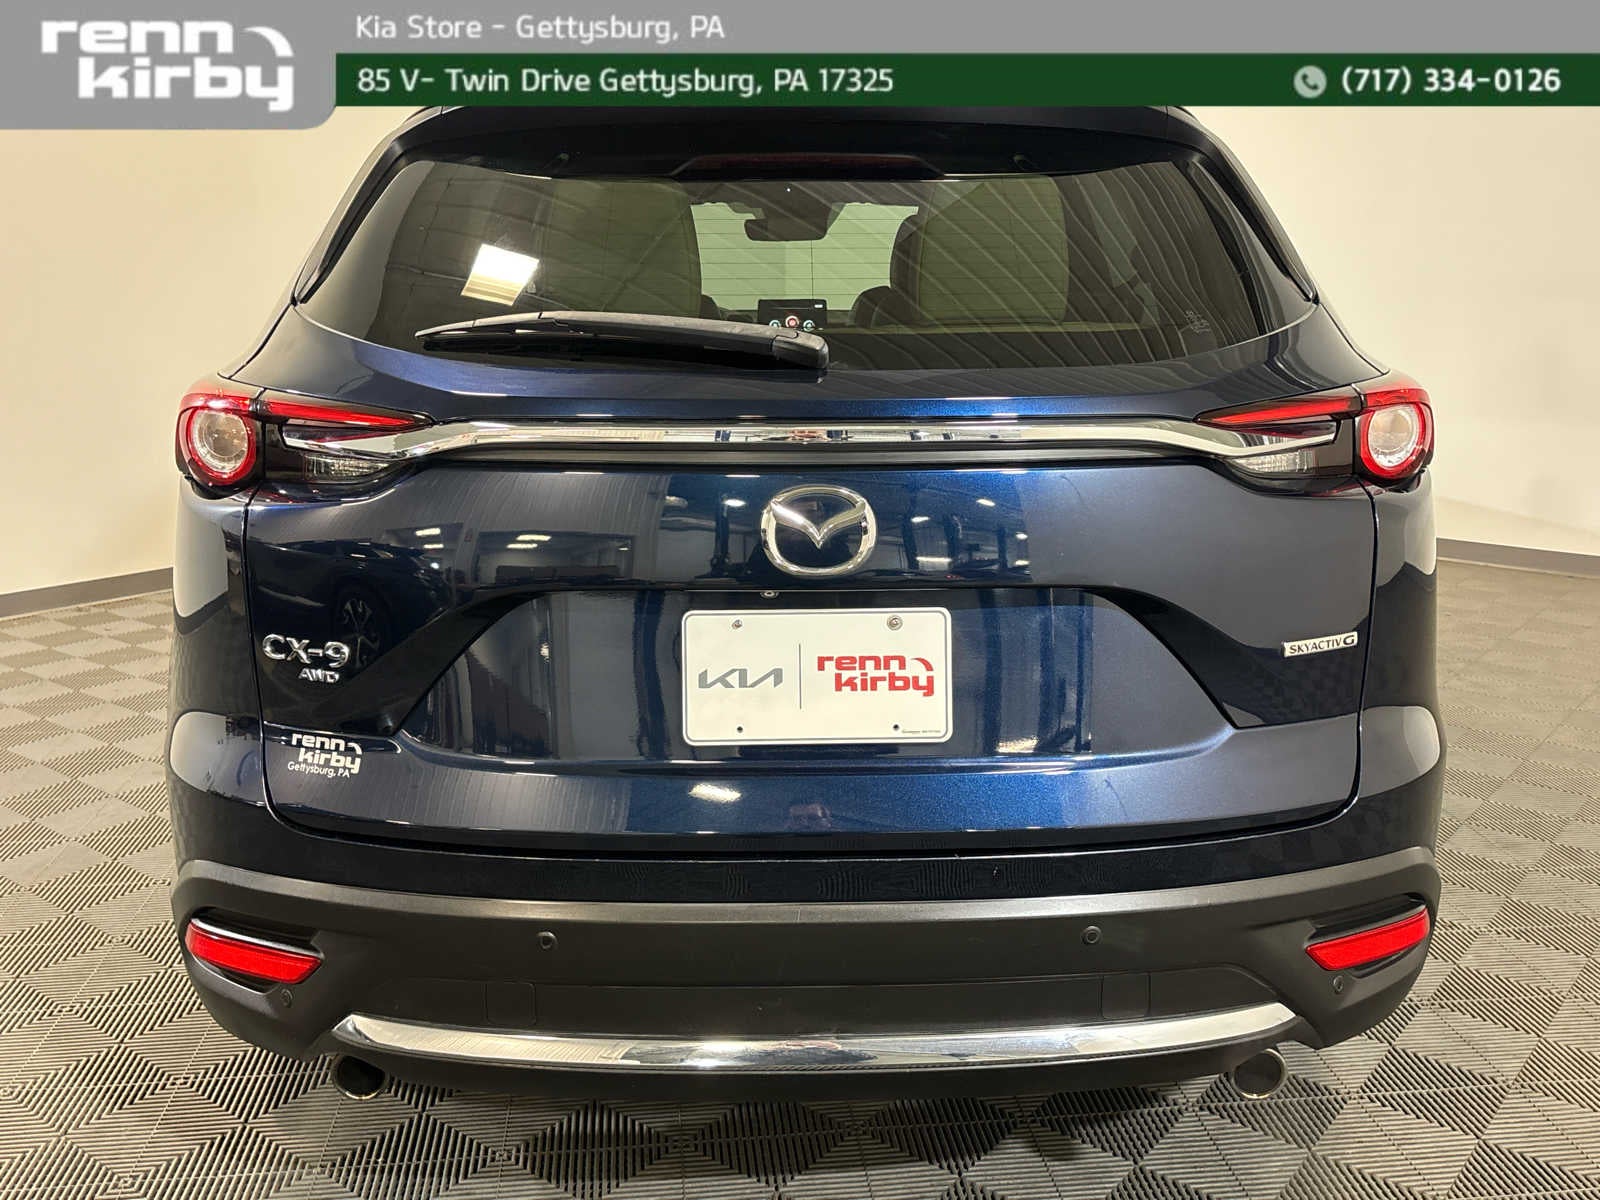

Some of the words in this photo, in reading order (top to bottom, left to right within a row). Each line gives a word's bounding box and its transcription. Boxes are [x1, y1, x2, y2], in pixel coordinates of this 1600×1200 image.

[262, 633, 351, 668] CX-9
[817, 655, 907, 672] renn
[299, 667, 339, 684] AWD
[834, 672, 935, 697] kirby
[291, 733, 346, 752] renn
[298, 747, 363, 774] kirby
[337, 766, 351, 779] PA
